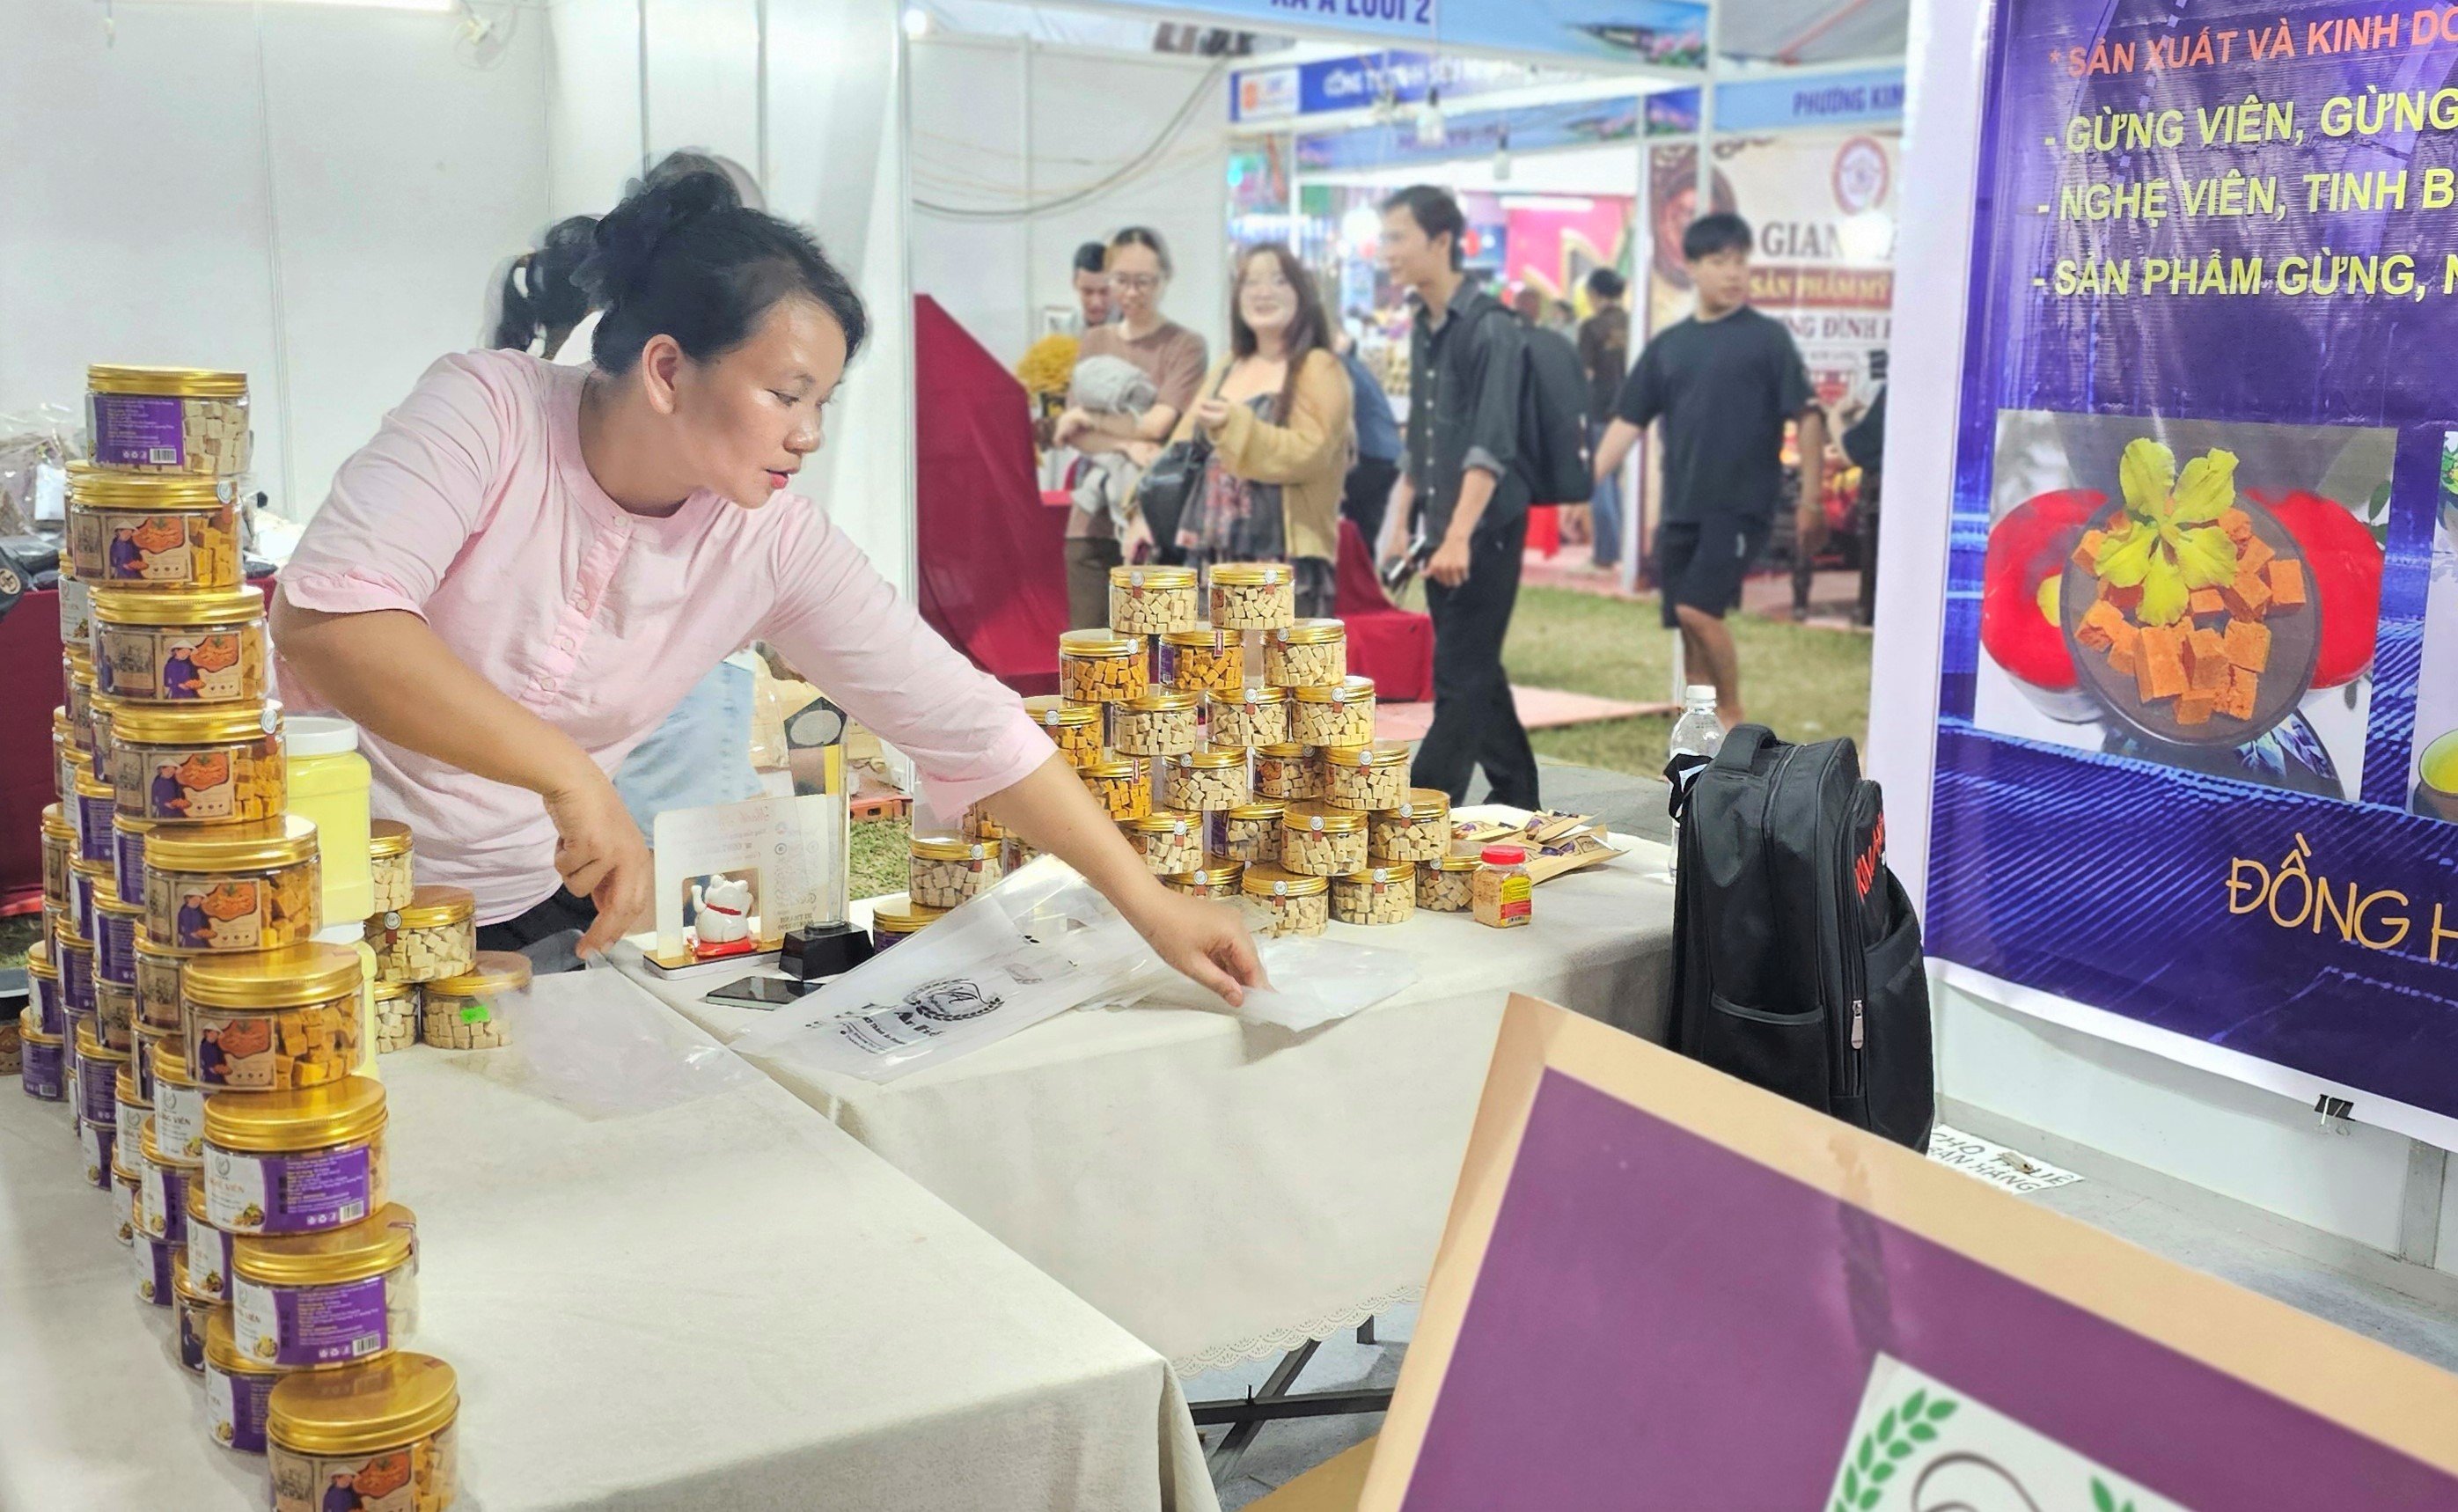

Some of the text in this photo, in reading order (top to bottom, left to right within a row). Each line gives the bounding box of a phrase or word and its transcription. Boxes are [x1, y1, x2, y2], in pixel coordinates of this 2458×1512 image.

[1413, 0, 1431, 25] 2
[2068, 38, 2136, 78] SẢN
[2144, 26, 2239, 70] XUẤT
[2248, 19, 2296, 58] VÀ
[2307, 13, 2400, 55] KINH
[2067, 84, 2458, 153] GỪNG VIÊN, GỪNG
[2060, 179, 2169, 227] NGHỆ
[2183, 168, 2286, 221] VIÊN,
[2302, 169, 2408, 212] TINH
[2055, 251, 2131, 296] SẢN
[2143, 248, 2263, 295] PHẨM
[2277, 246, 2425, 303] GỪNG,
[2225, 833, 2410, 950] ĐỒNG
